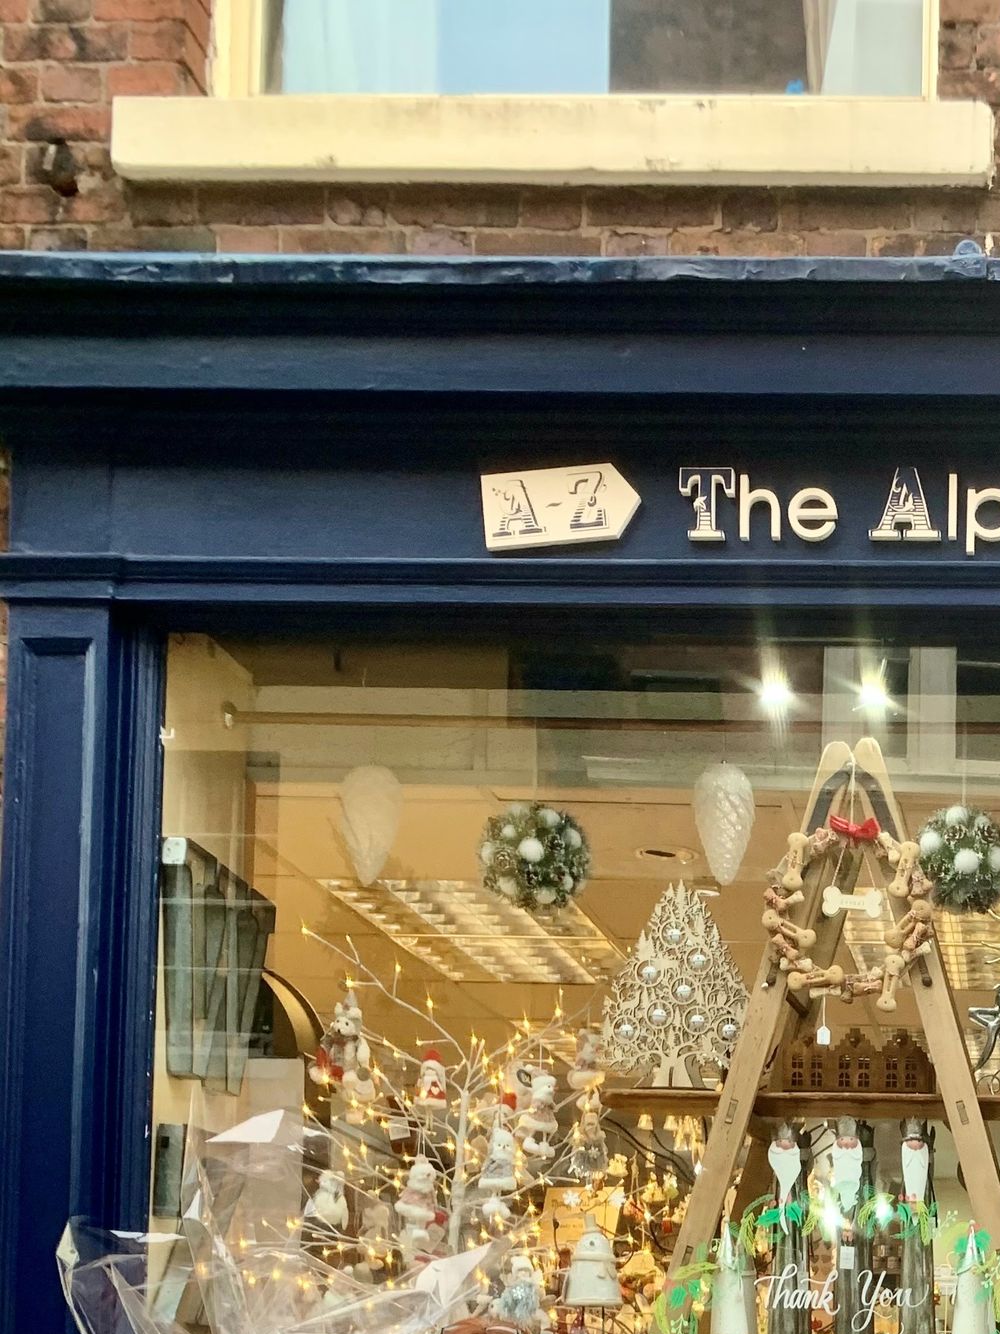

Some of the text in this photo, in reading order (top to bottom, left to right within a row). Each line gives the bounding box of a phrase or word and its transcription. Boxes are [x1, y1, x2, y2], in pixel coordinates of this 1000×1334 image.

[679, 466, 839, 542] The
[753, 1264, 931, 1333] Thank You
